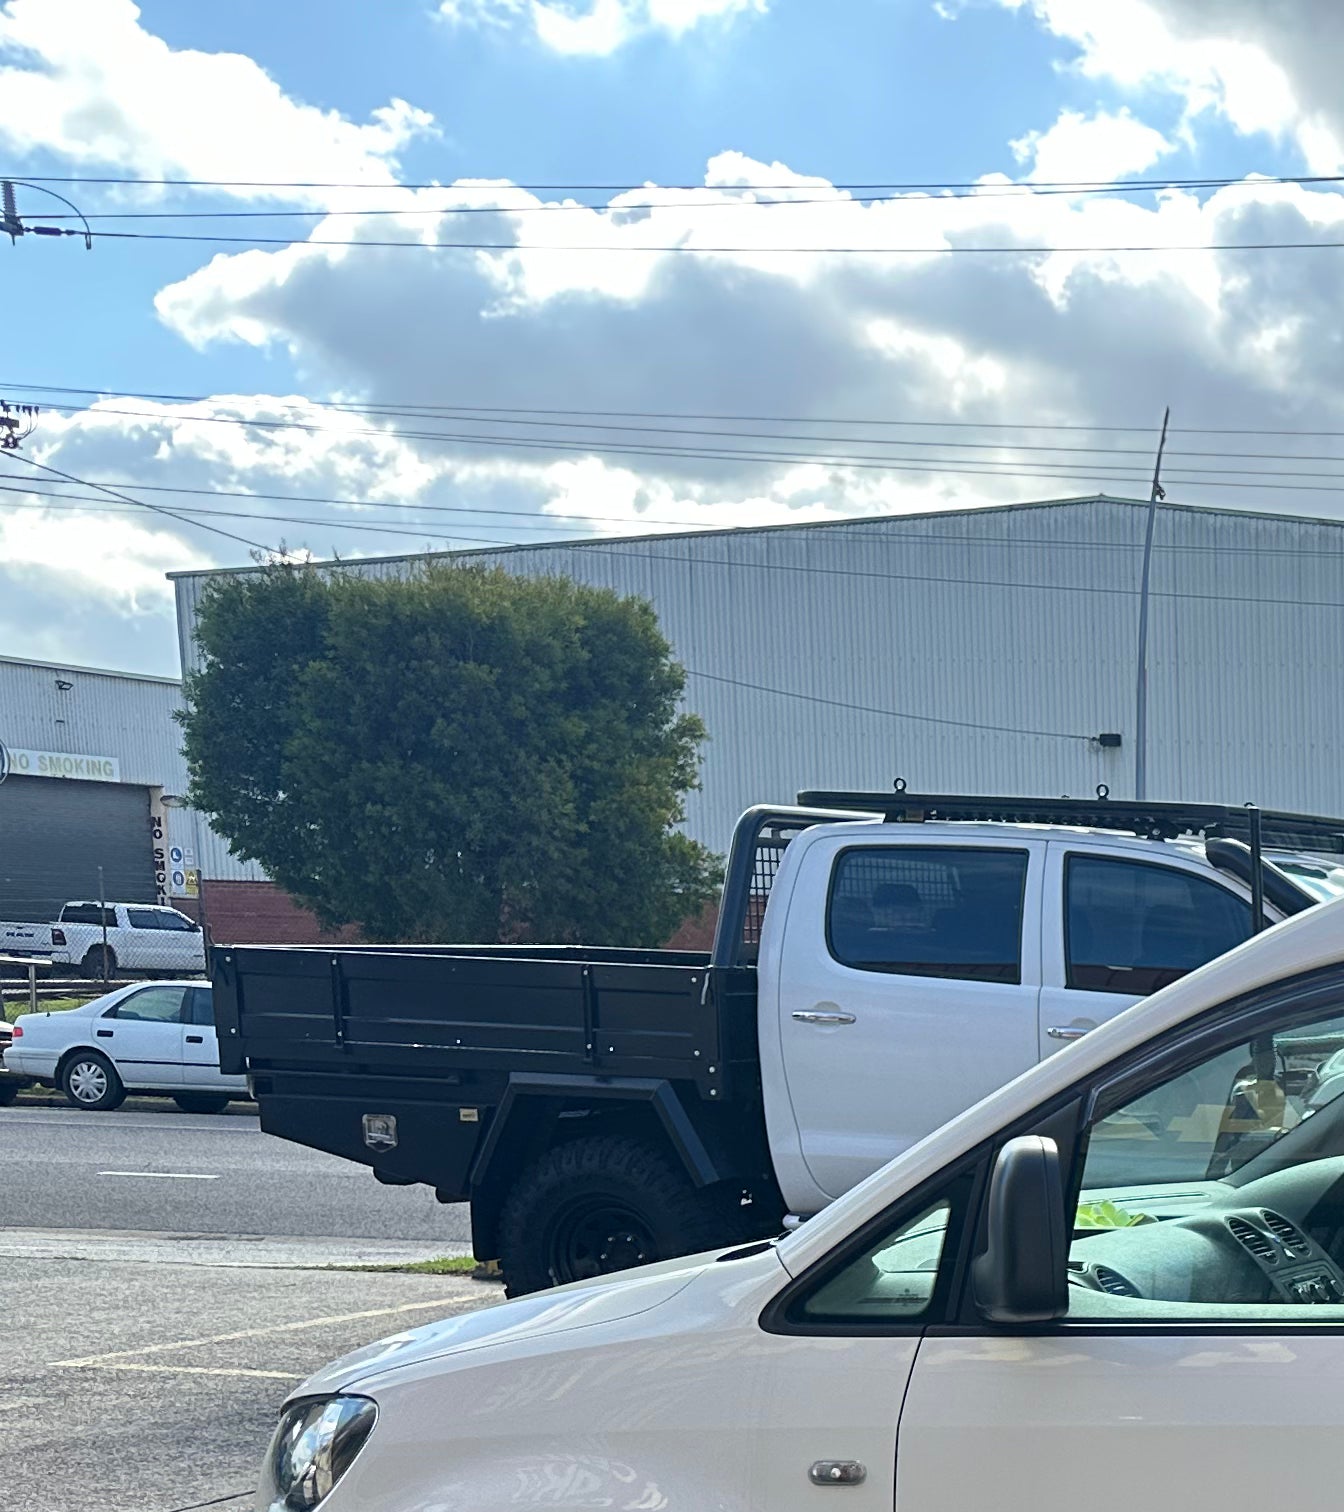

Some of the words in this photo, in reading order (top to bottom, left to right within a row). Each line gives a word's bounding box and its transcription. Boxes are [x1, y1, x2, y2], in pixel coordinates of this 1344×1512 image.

[38, 755, 114, 777] SMOKING
[151, 816, 162, 839] NO
[154, 848, 167, 906] SMOKI
